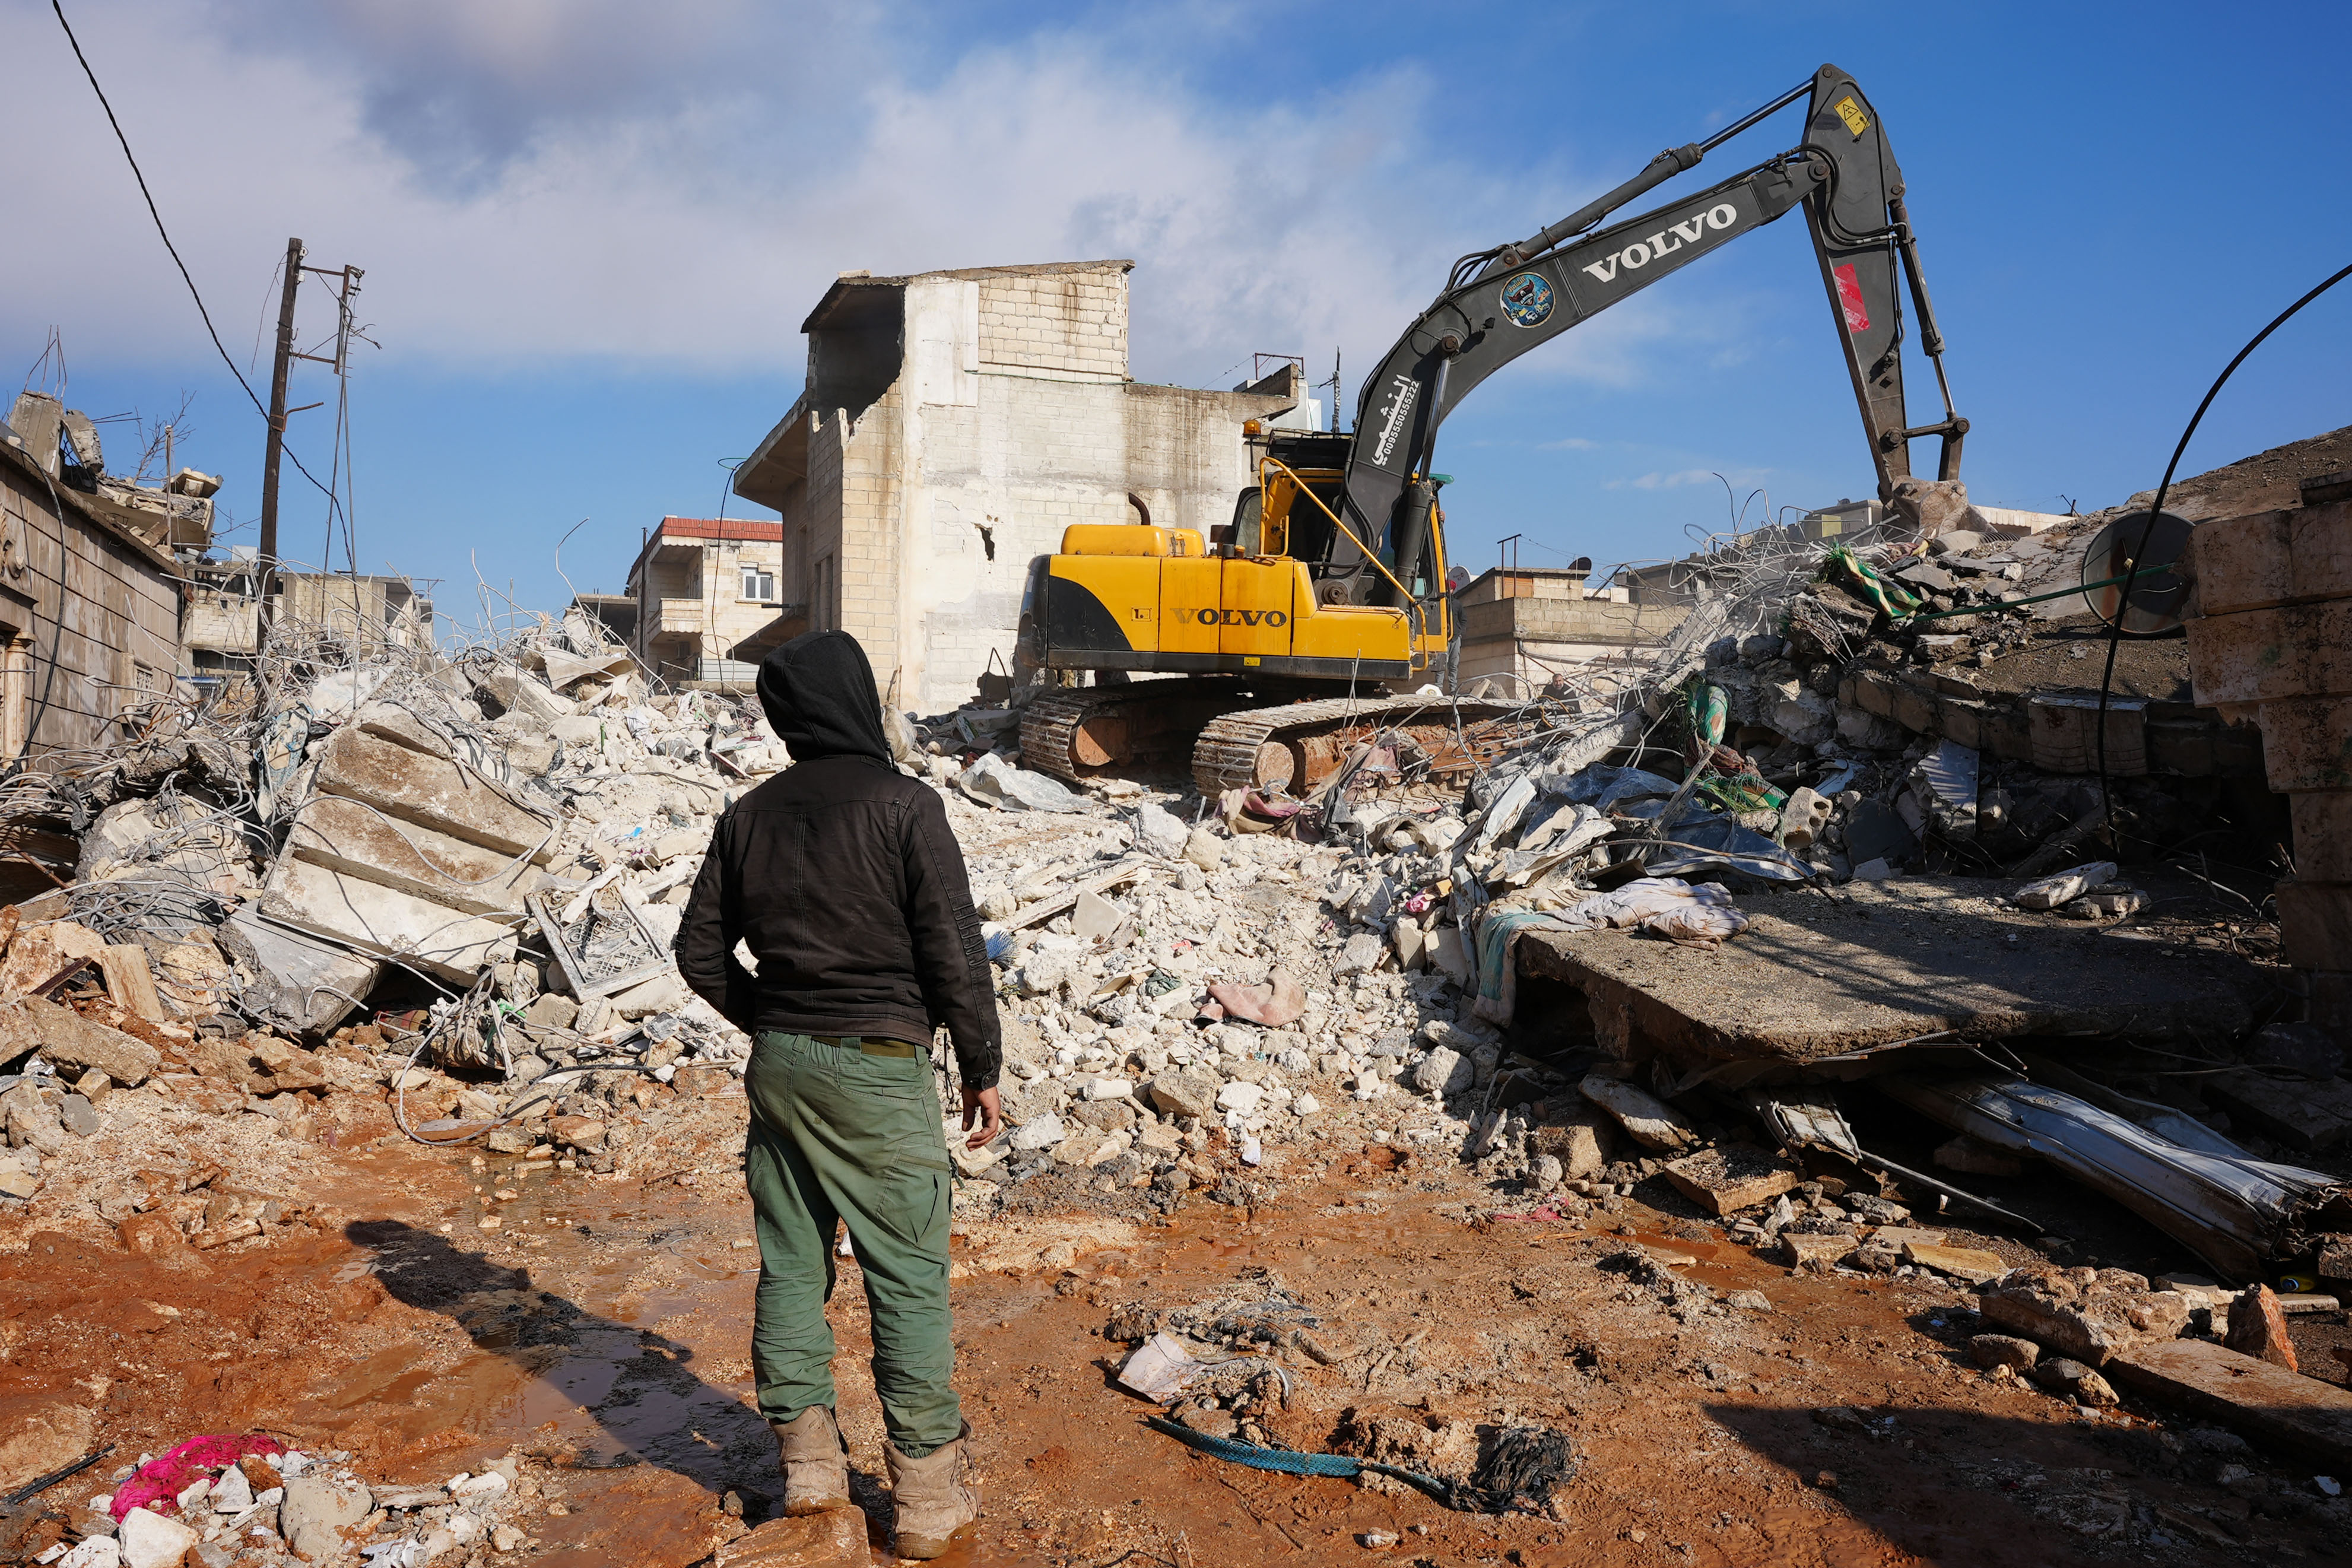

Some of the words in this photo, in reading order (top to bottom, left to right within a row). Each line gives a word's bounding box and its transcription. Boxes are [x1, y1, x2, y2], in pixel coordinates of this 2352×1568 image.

[1582, 204, 1737, 283] VOLVO
[1372, 374, 1412, 466] النشمي
[1383, 380, 1420, 455] 0095550555222
[1170, 608, 1287, 627] VOLVO
